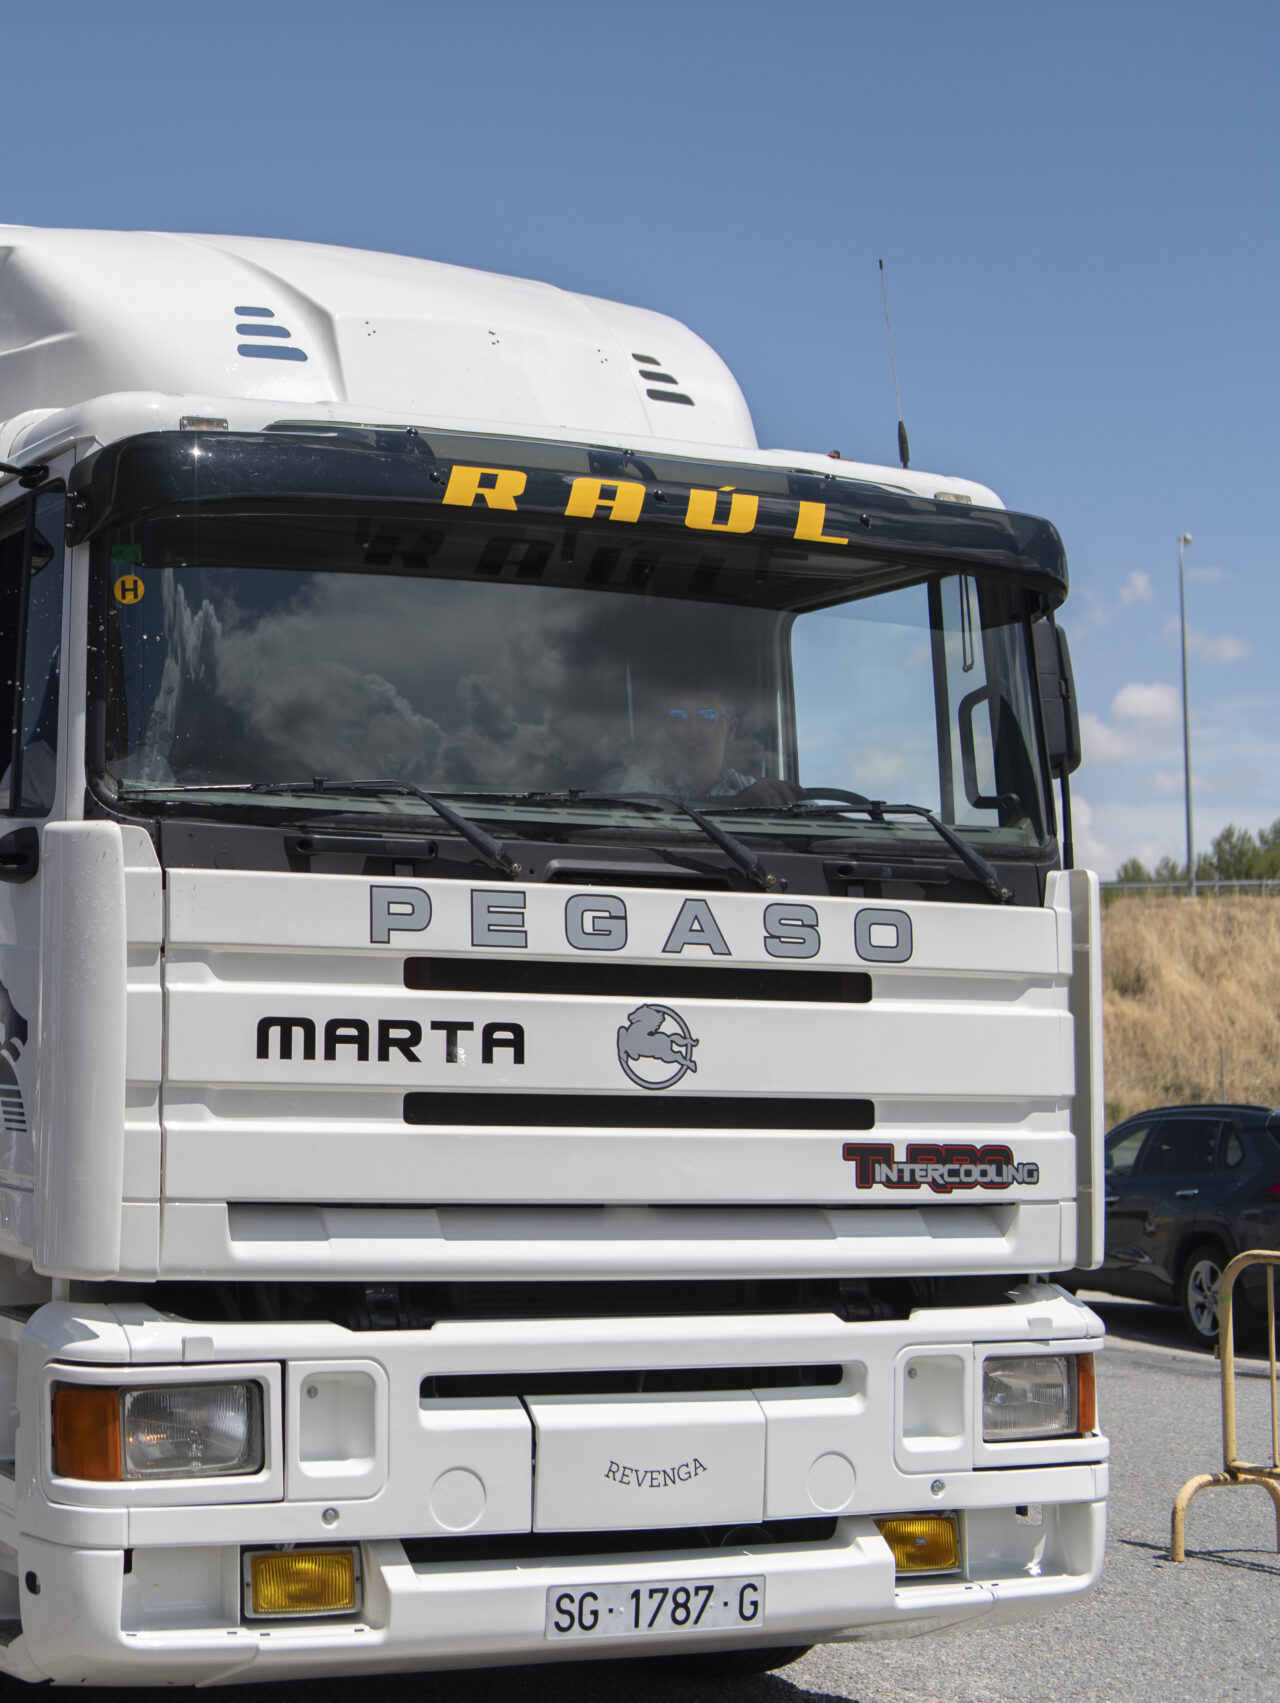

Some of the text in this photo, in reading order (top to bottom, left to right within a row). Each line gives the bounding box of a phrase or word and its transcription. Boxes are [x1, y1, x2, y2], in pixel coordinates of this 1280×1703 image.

[441, 465, 849, 546] RAÚL
[120, 578, 139, 600] H
[369, 884, 914, 964] PEGASO
[256, 1016, 525, 1065] MARTA
[874, 1162, 1040, 1185] INTERCOOLING
[604, 1457, 708, 1488] REVENGA
